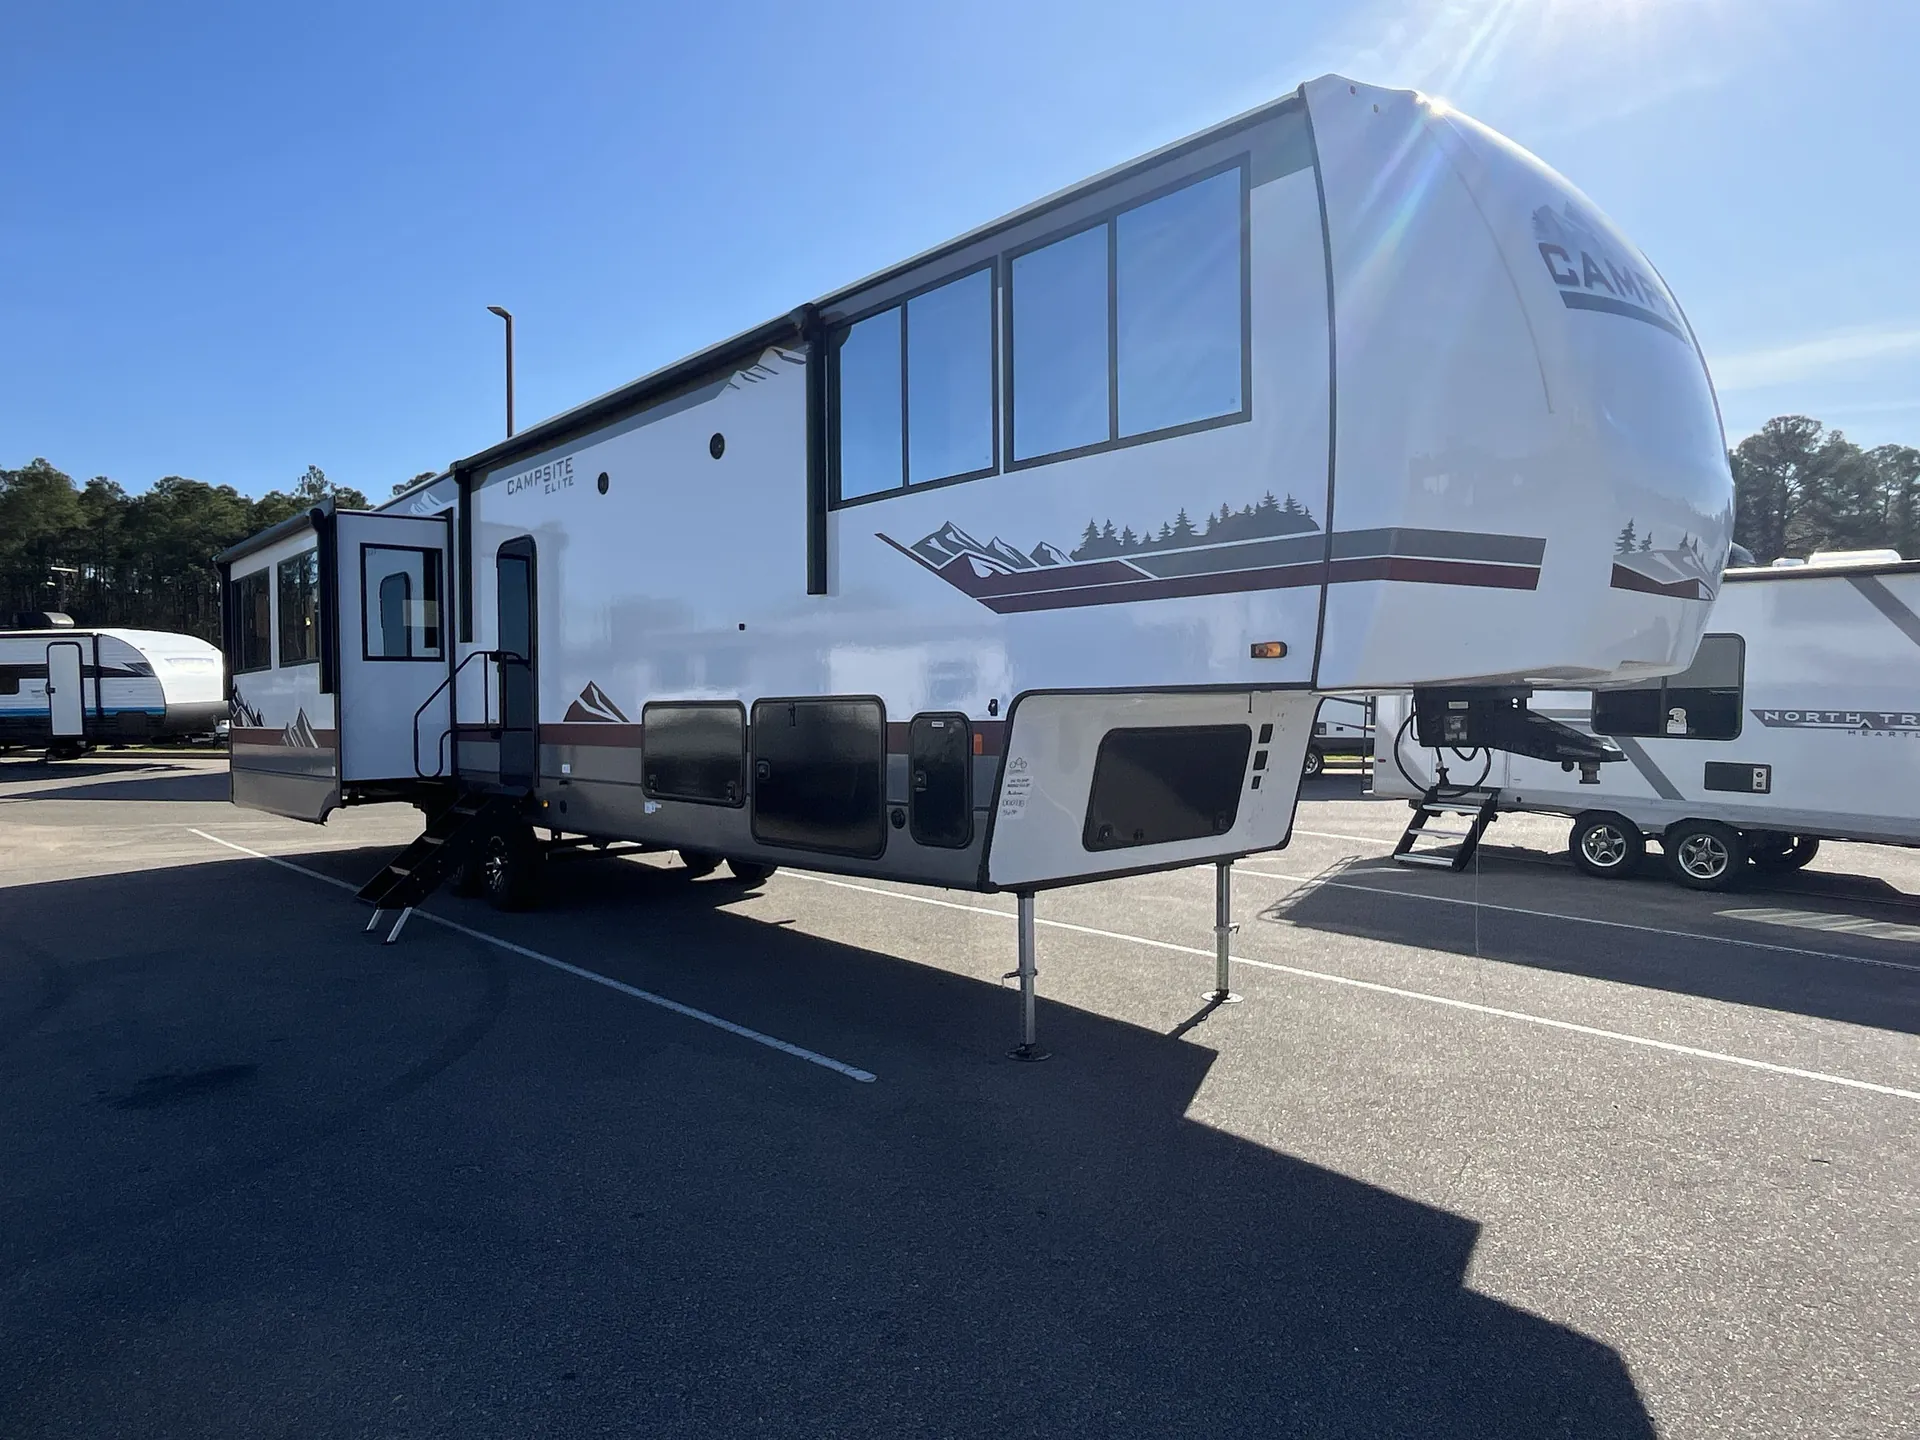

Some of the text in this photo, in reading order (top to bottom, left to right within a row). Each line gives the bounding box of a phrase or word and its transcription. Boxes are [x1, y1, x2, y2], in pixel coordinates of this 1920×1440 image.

[507, 457, 573, 495] CAMPSITE
[544, 475, 574, 495] ELITE
[1763, 711, 1861, 723] NORTH
